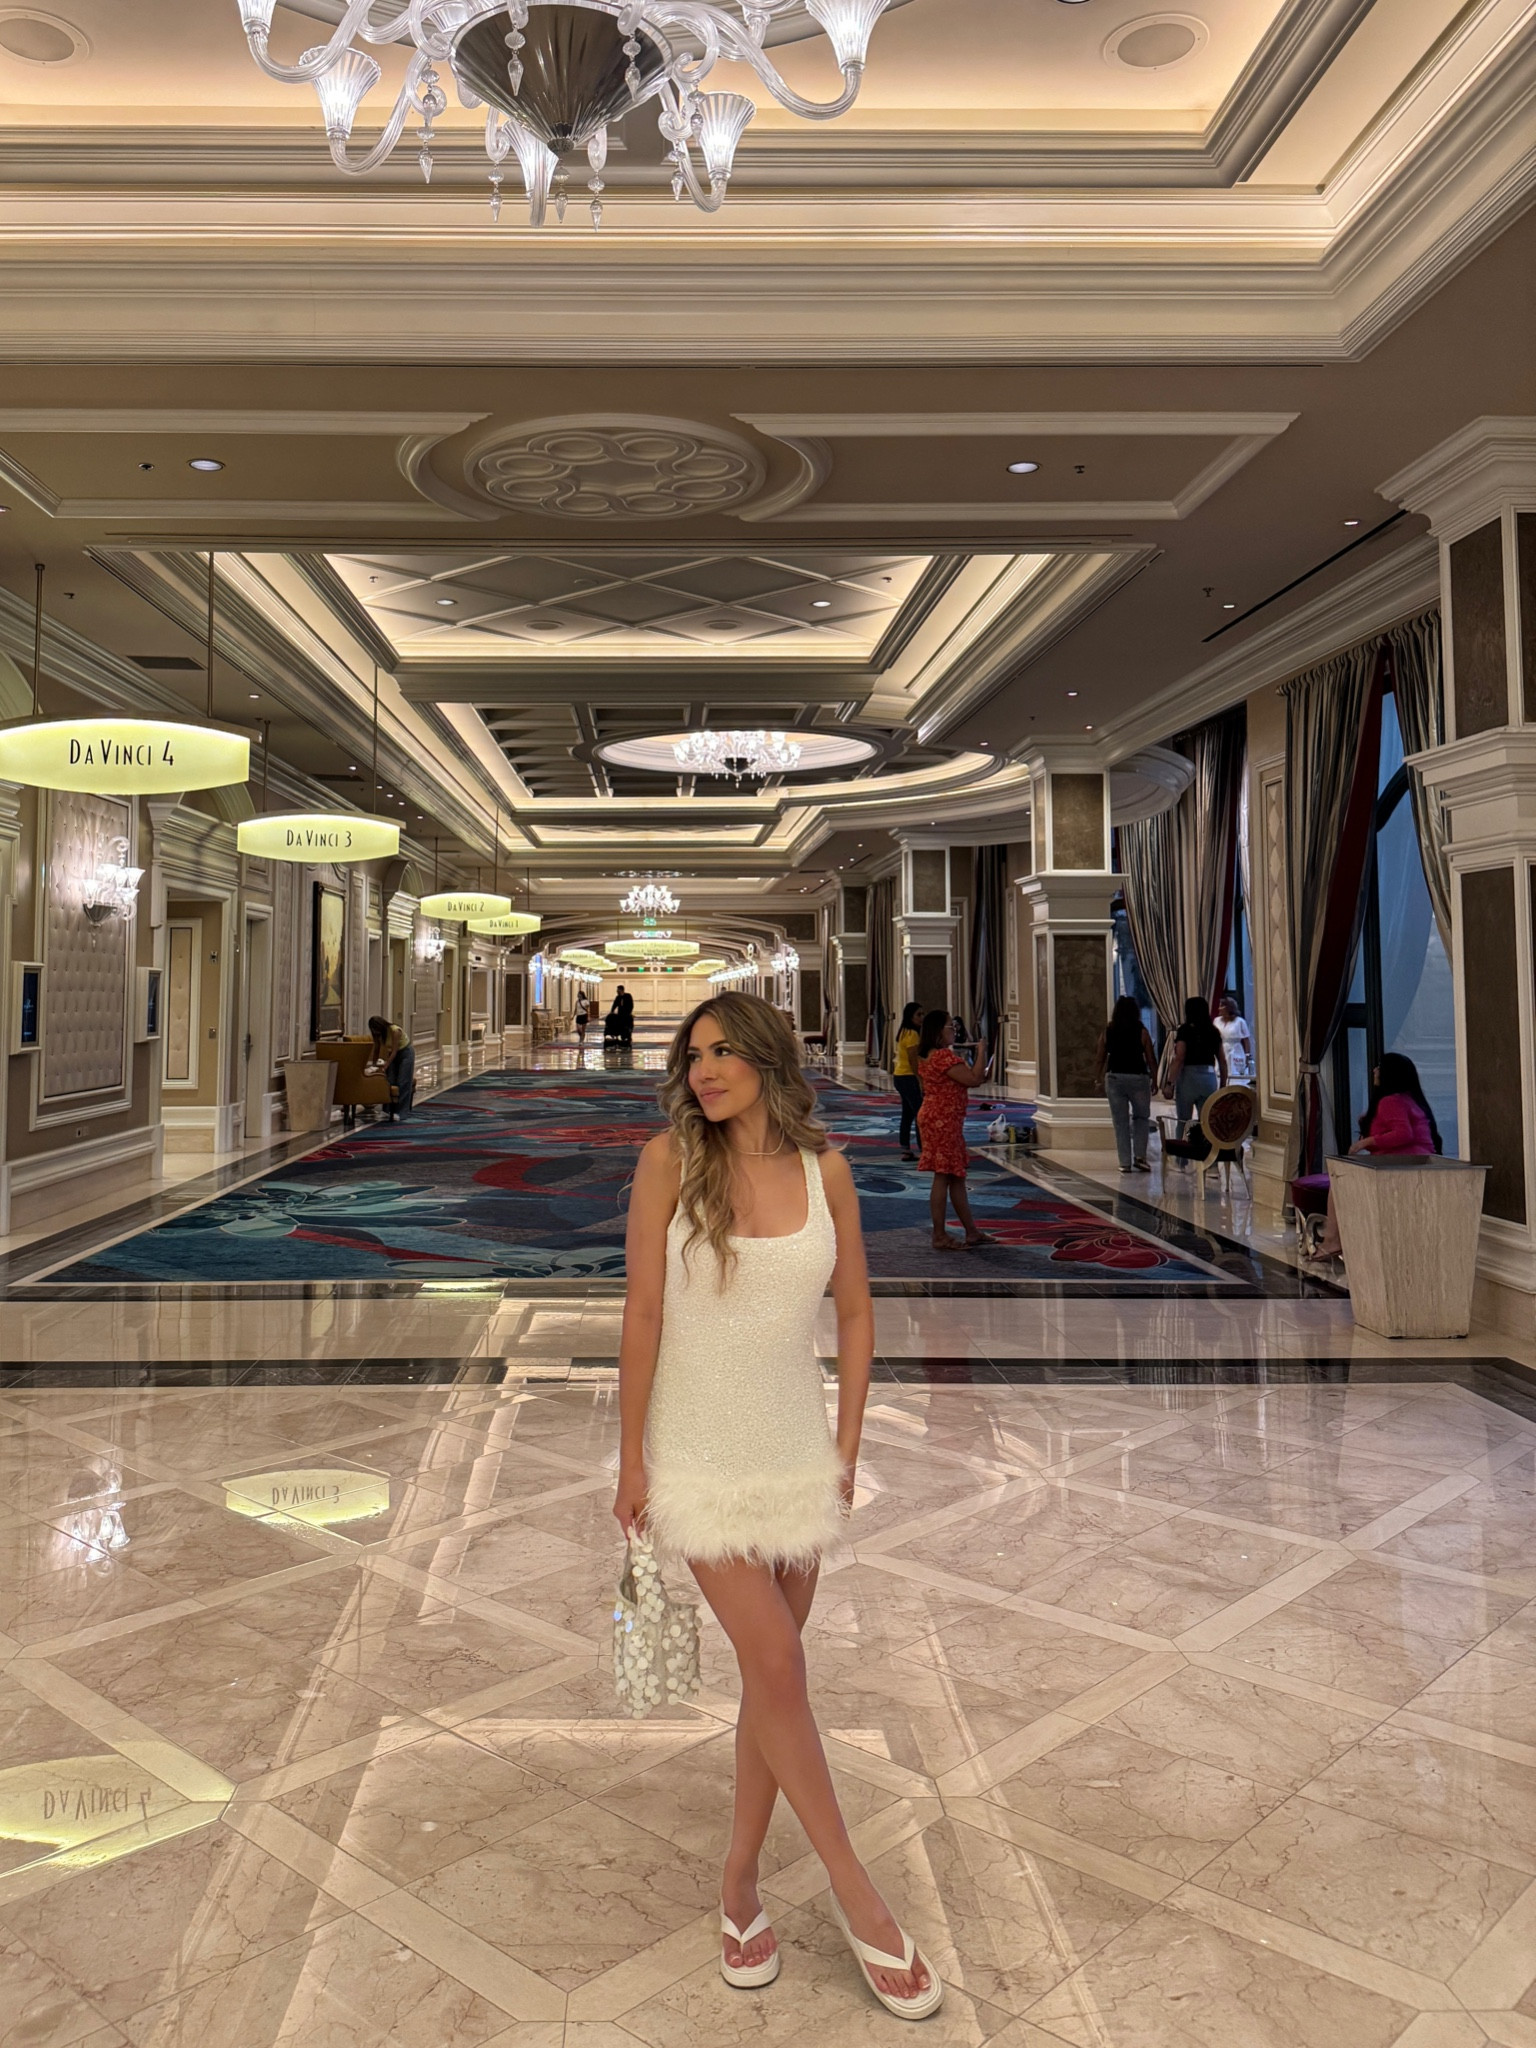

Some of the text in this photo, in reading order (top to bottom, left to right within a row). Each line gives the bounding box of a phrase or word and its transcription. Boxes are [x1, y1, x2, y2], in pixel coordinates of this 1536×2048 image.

[161, 740, 174, 766] 4
[344, 830, 352, 848] 3
[479, 902, 485, 912] 2
